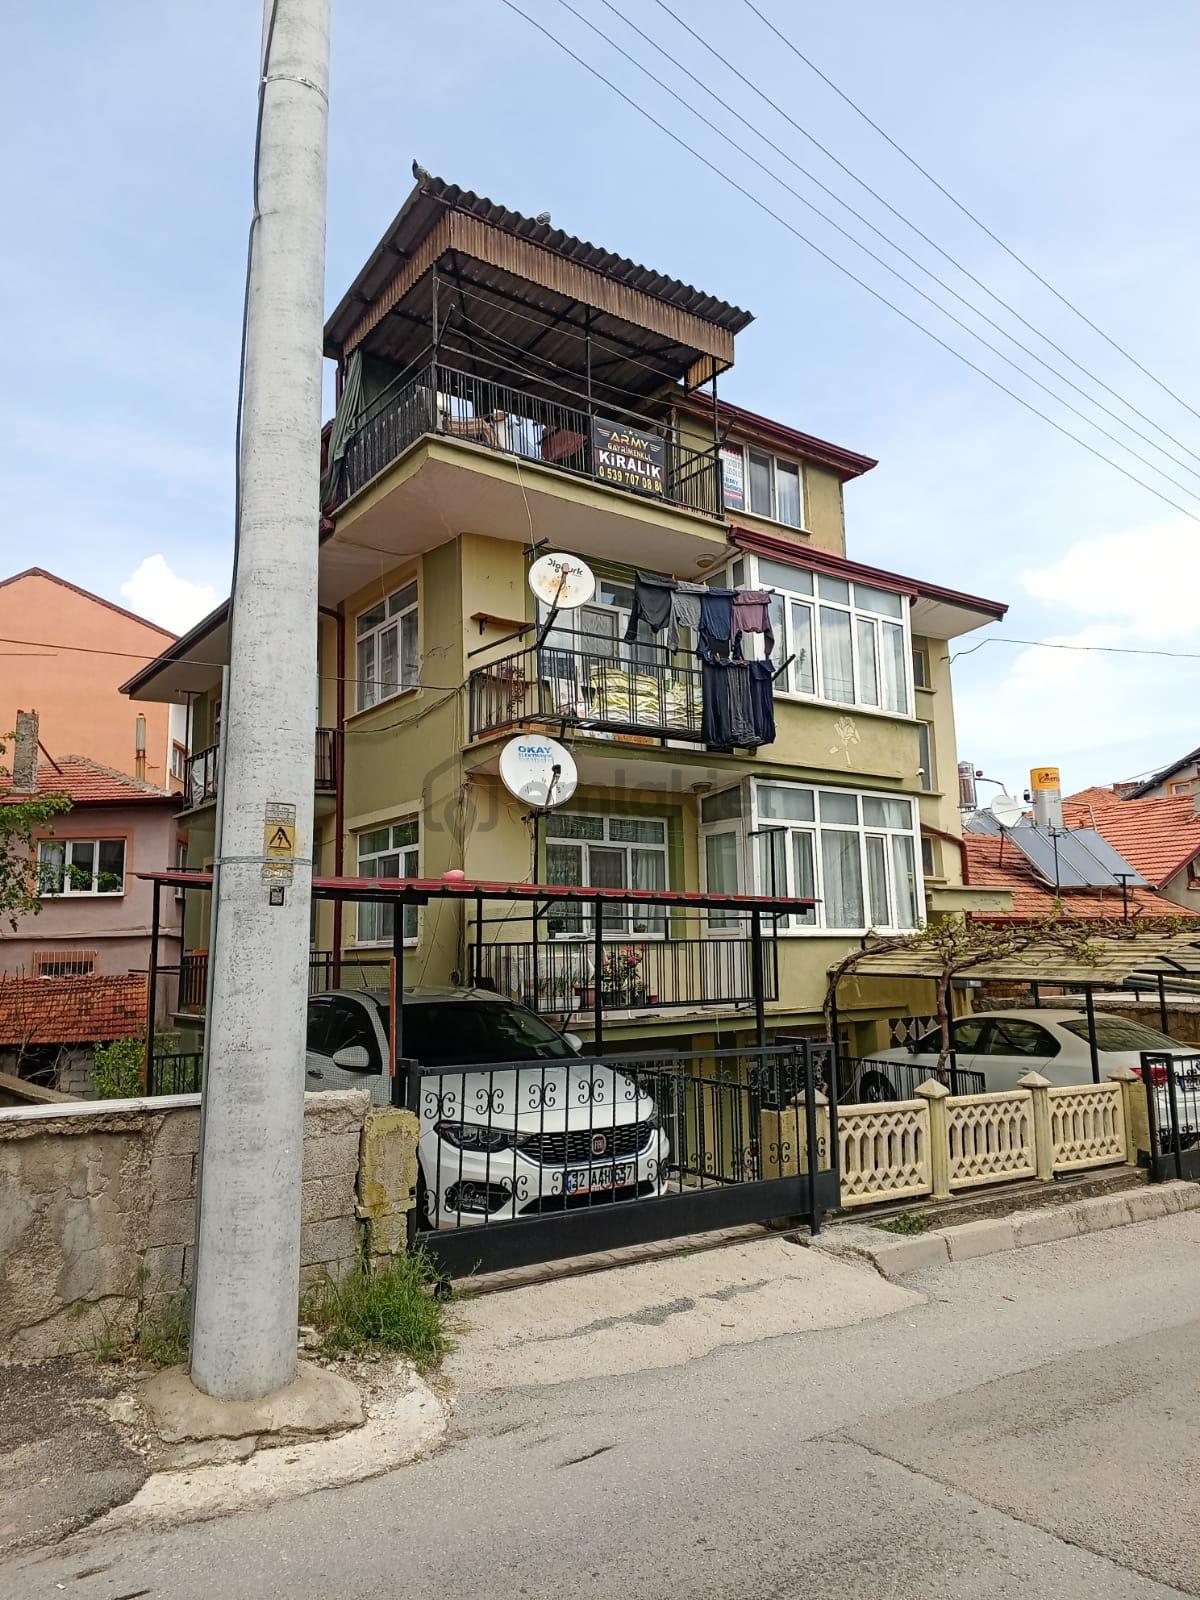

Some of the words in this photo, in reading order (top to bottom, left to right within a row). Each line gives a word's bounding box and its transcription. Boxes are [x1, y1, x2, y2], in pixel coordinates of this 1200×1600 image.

[610, 431, 649, 450] ARMY
[599, 466, 604, 477] 0
[607, 468, 623, 481] 539
[625, 472, 639, 486] 707
[518, 745, 552, 754] OKAY
